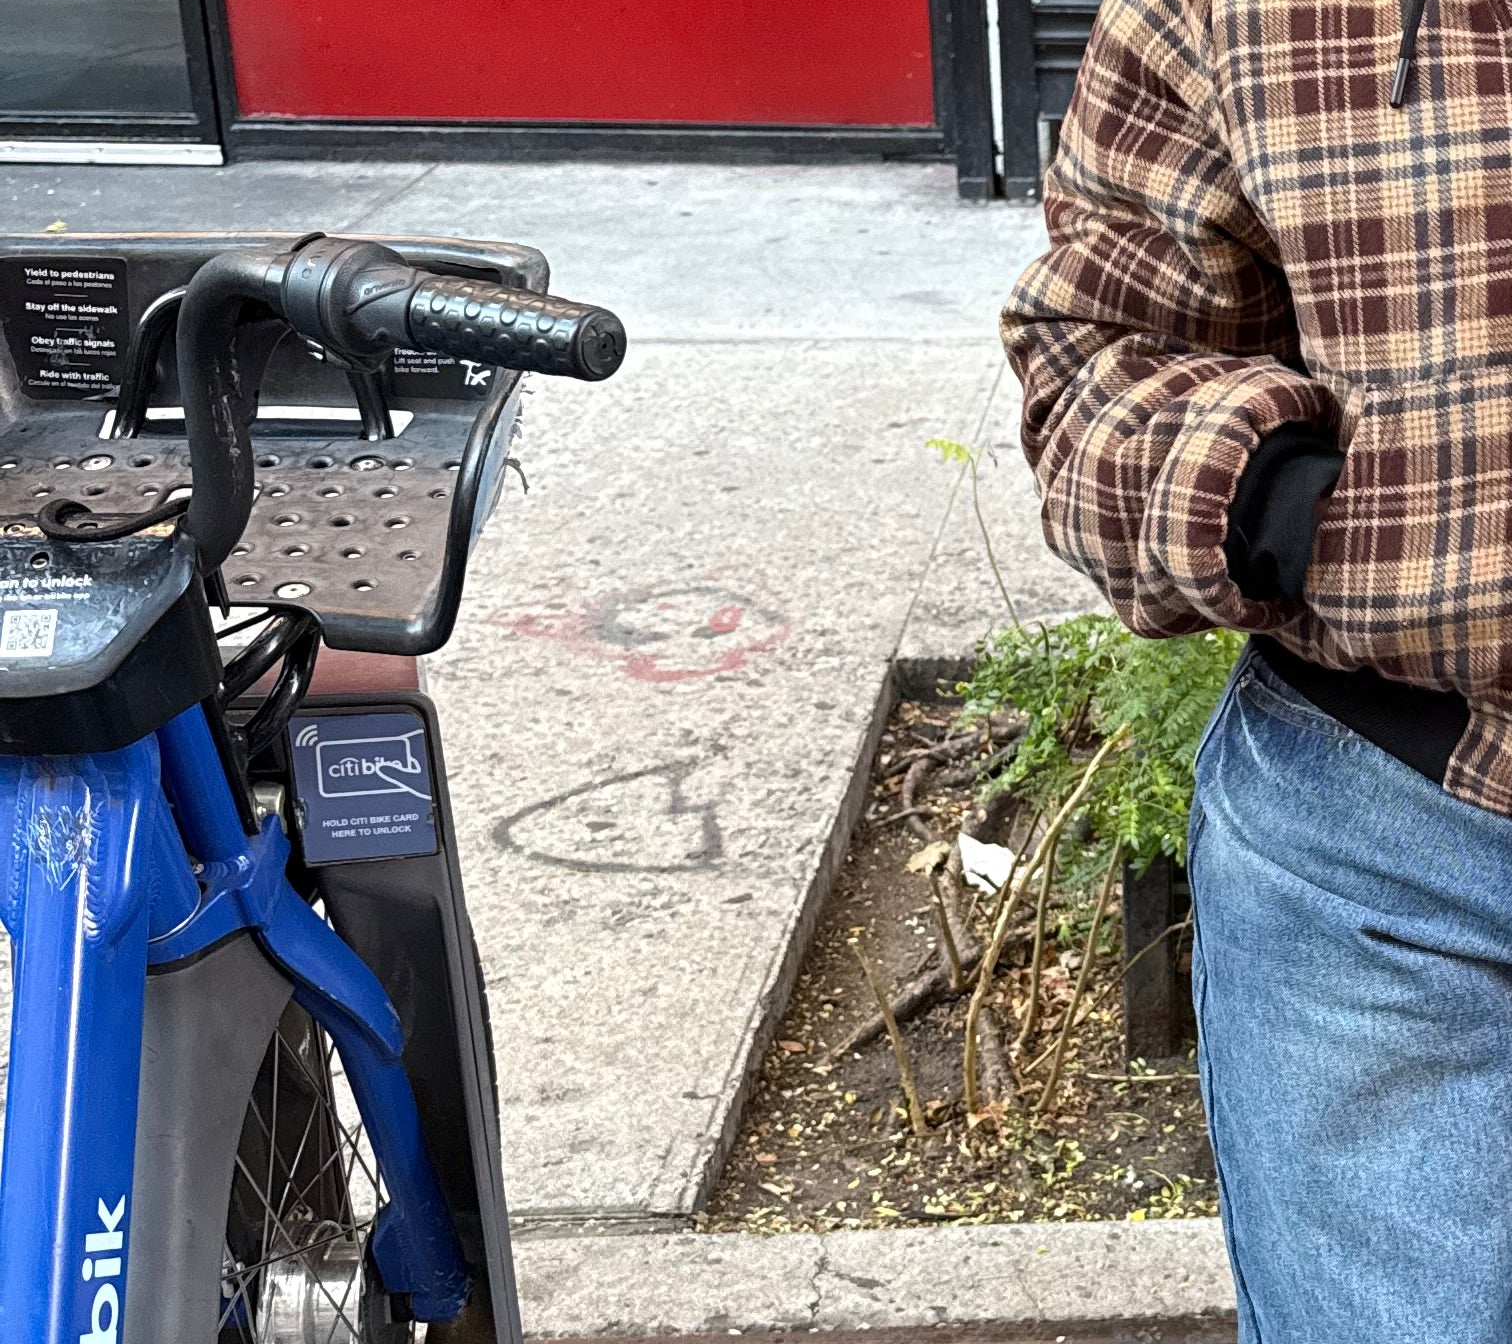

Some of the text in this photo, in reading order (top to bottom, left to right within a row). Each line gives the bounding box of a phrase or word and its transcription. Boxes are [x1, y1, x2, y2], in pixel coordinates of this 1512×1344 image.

[24, 267, 115, 281] Yield to pedestrians
[25, 301, 118, 315] Stay off the sidewalk
[31, 336, 55, 347] Obey
[84, 338, 115, 349] signals
[39, 369, 110, 382] Ride with traffic
[0, 574, 93, 589] an to unlock
[329, 757, 359, 778] citi
[322, 813, 419, 828] HOLD CITI BIKE CARD
[331, 825, 412, 838] HERE TO UNLOCK
